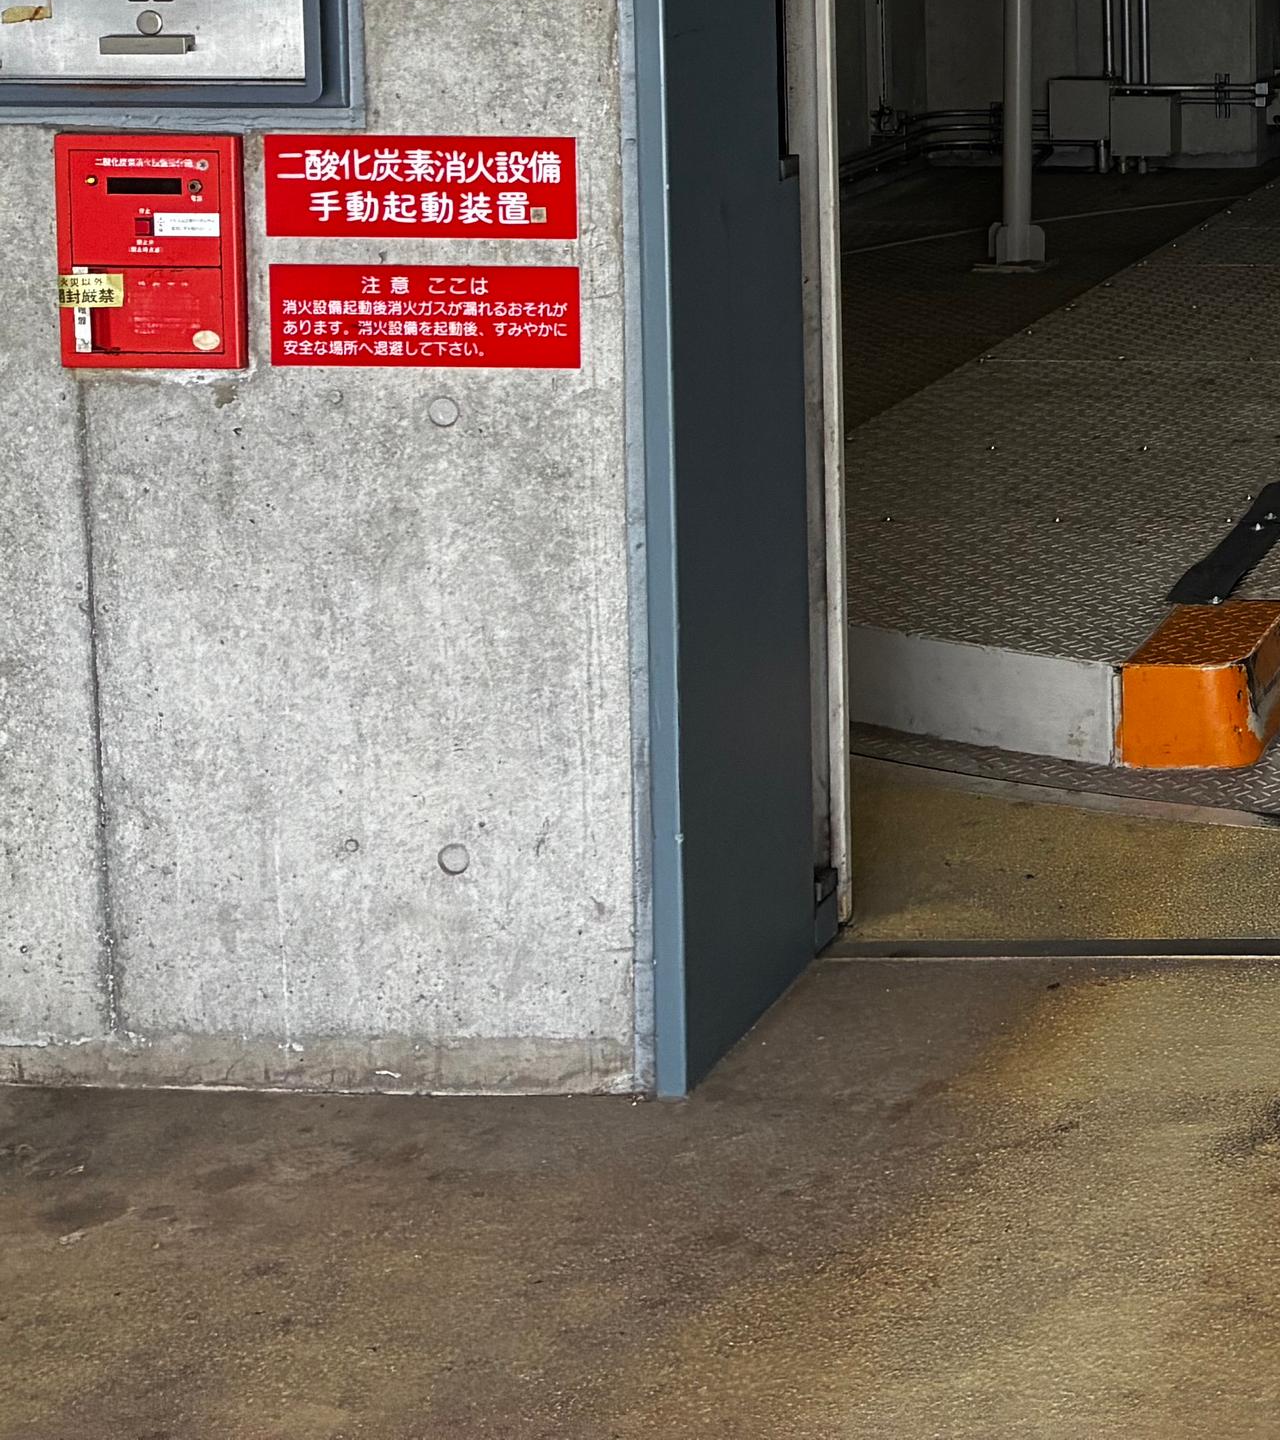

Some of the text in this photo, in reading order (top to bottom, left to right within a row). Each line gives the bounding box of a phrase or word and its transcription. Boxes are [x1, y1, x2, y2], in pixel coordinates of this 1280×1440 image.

[277, 148, 562, 184] 二酸化炭素消火設備
[309, 190, 530, 225] 手動起動装置
[361, 276, 489, 295] 注意 ここは
[282, 299, 568, 318] 消火設備起動後消火ガスが漏れるおそれが
[282, 319, 568, 338] あります。消火設備を起動後、すみやかに
[283, 340, 486, 357] 安全な場所へ退避して下さい。
